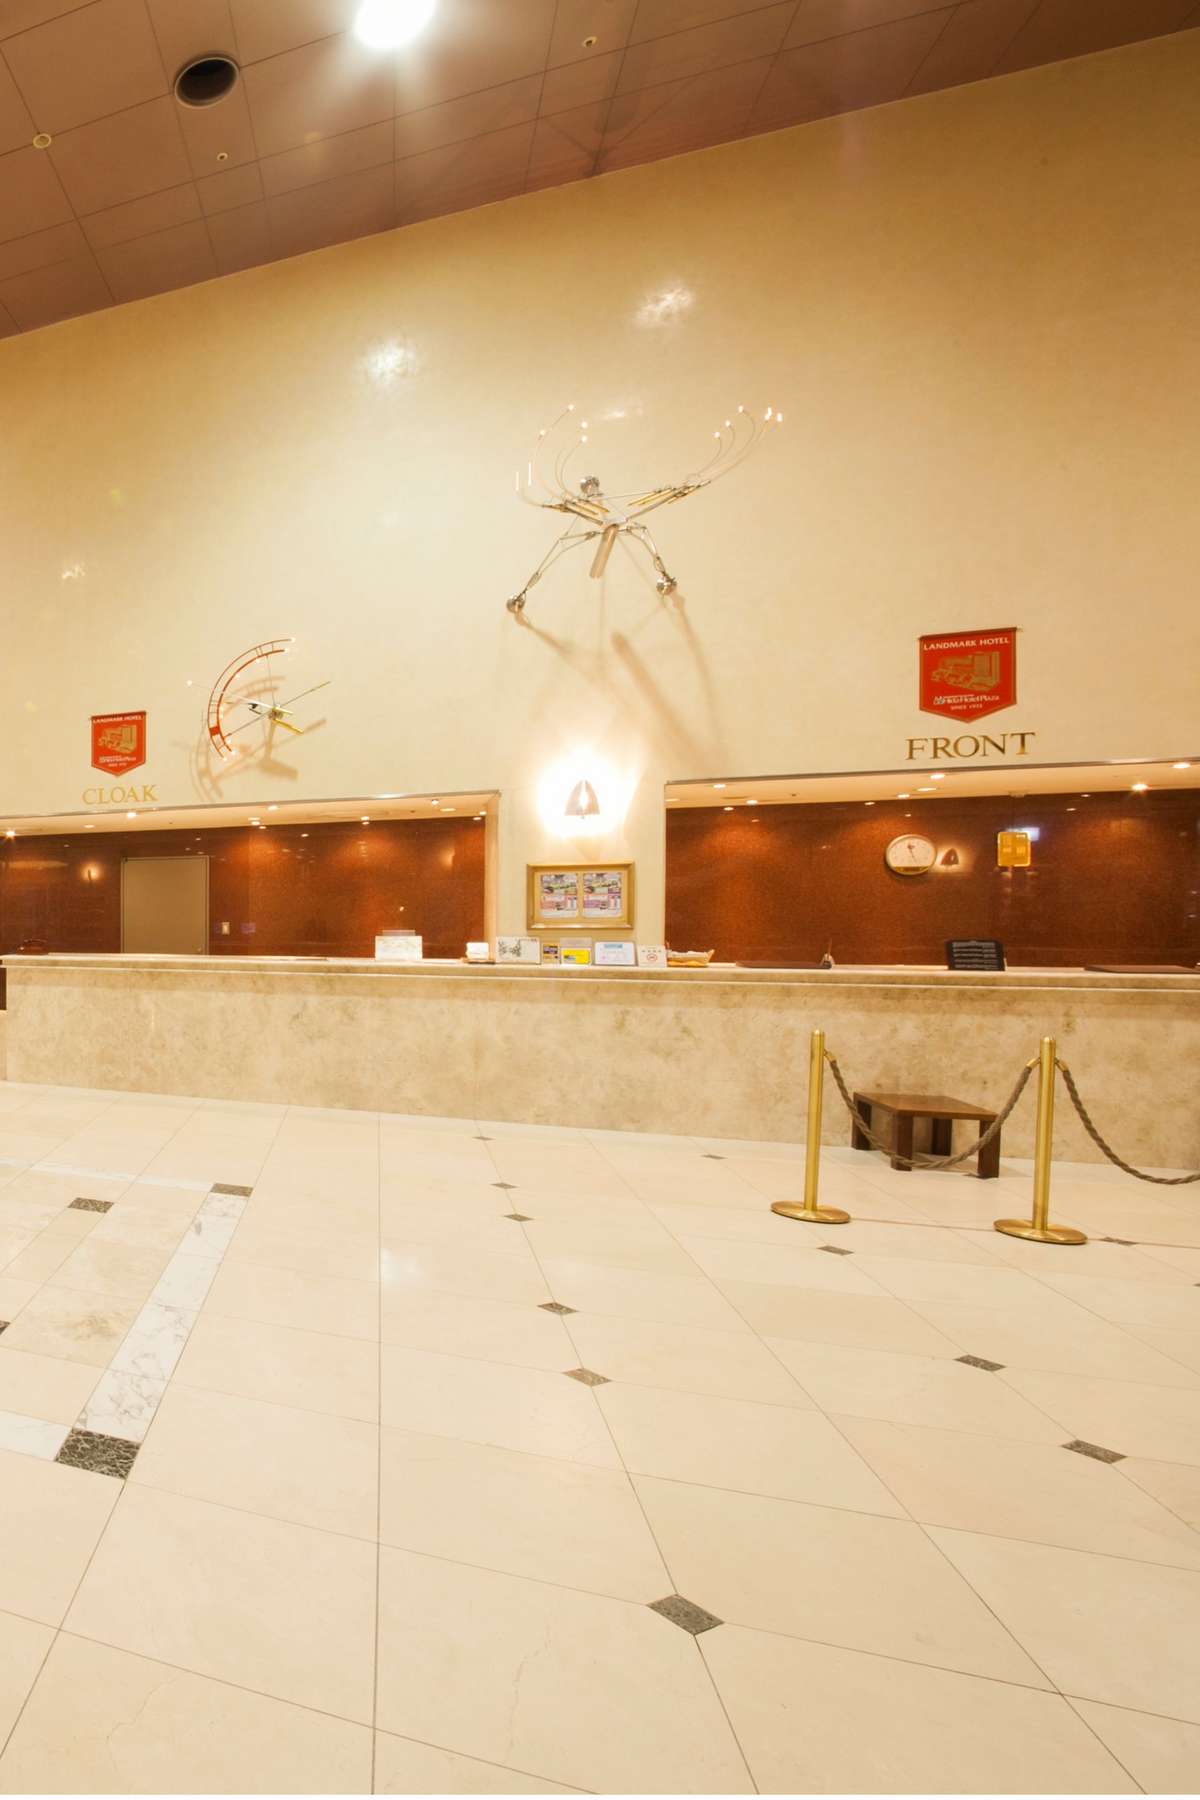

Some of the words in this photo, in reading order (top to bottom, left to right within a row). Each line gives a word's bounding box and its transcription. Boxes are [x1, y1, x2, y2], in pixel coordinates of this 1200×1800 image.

[923, 640, 977, 651] LANDMARK
[979, 637, 1010, 646] HOTEL
[905, 732, 1036, 760] FRONT
[82, 784, 159, 805] CLOAK
